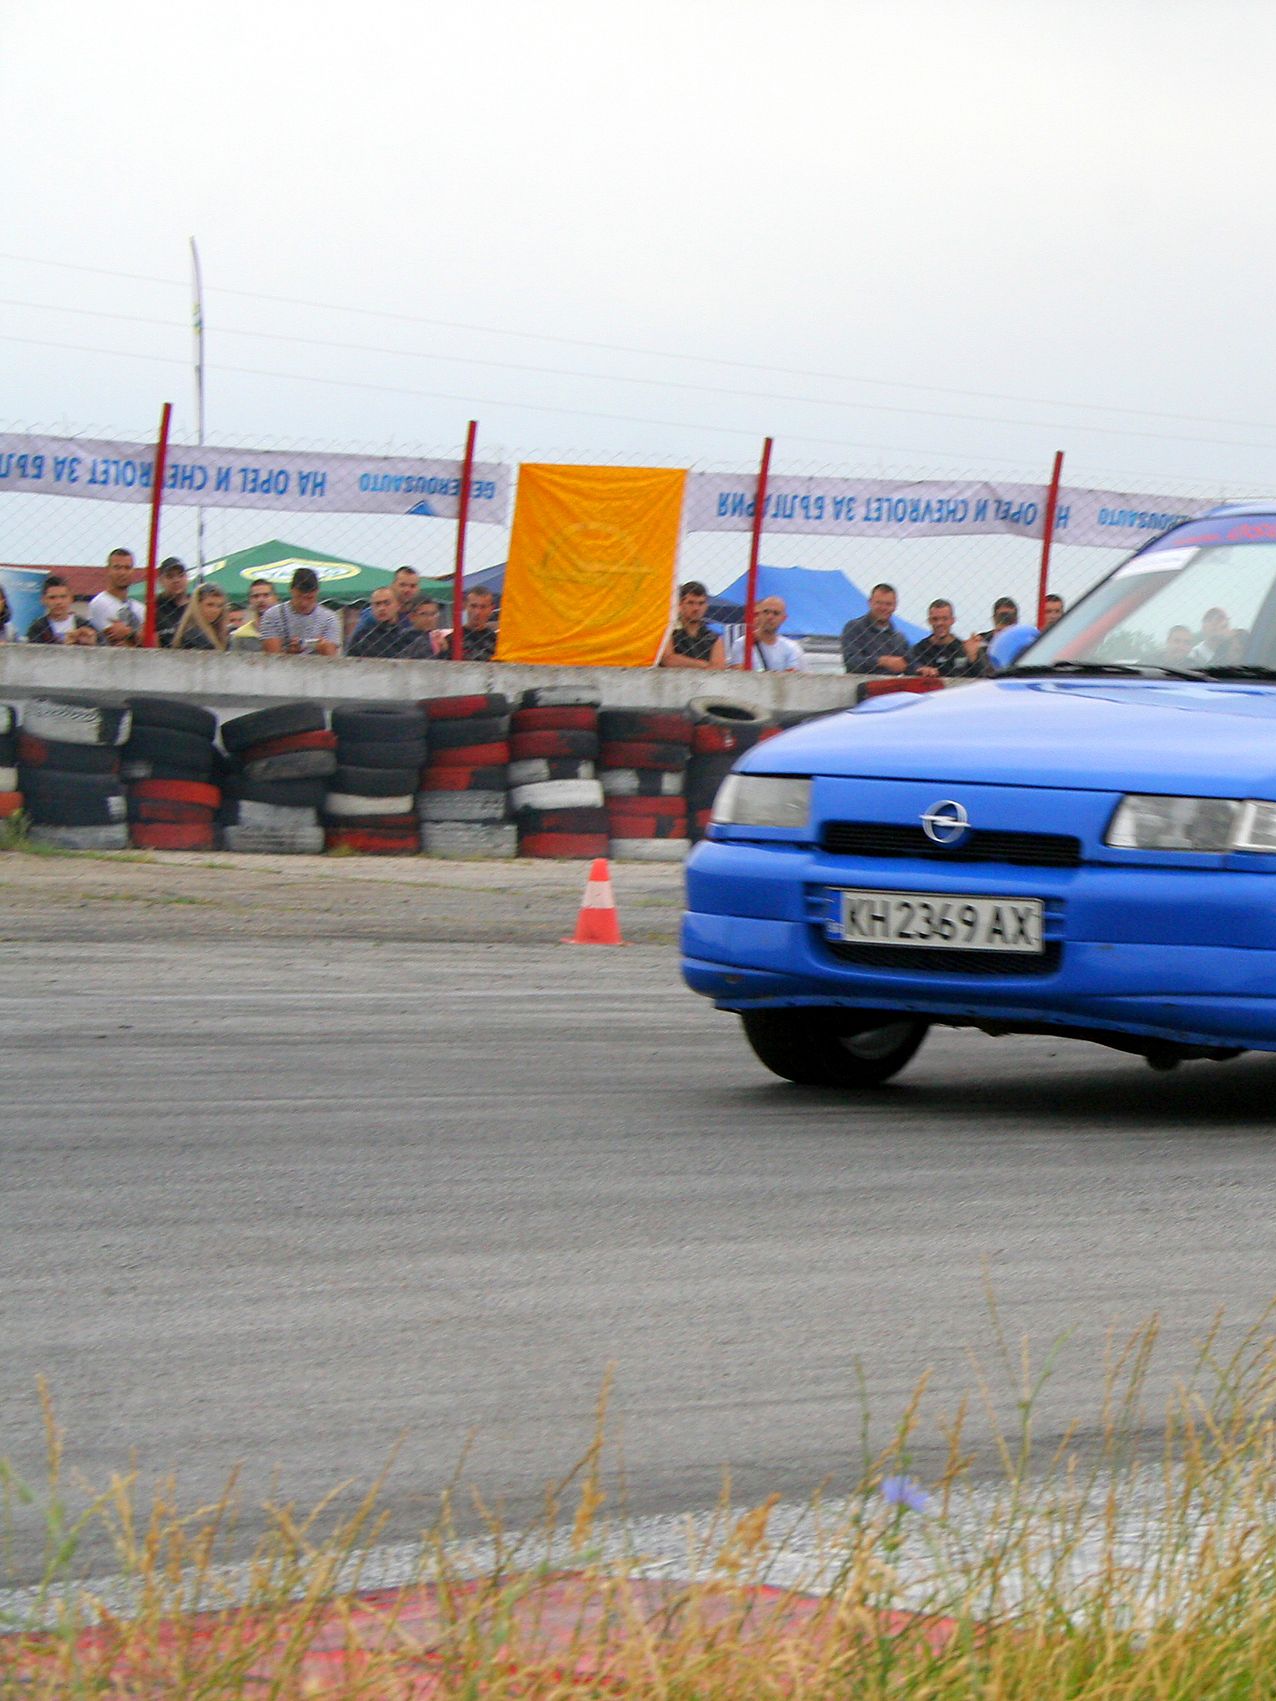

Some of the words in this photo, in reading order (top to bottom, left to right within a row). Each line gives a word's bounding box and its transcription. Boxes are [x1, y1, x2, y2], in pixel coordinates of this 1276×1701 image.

[86, 457, 210, 492] CHEROLET
[238, 466, 289, 496] OPEL
[358, 472, 498, 500] GEEROUSAUTO
[861, 495, 970, 524] CHEVROLET
[992, 498, 1040, 527] OPEL
